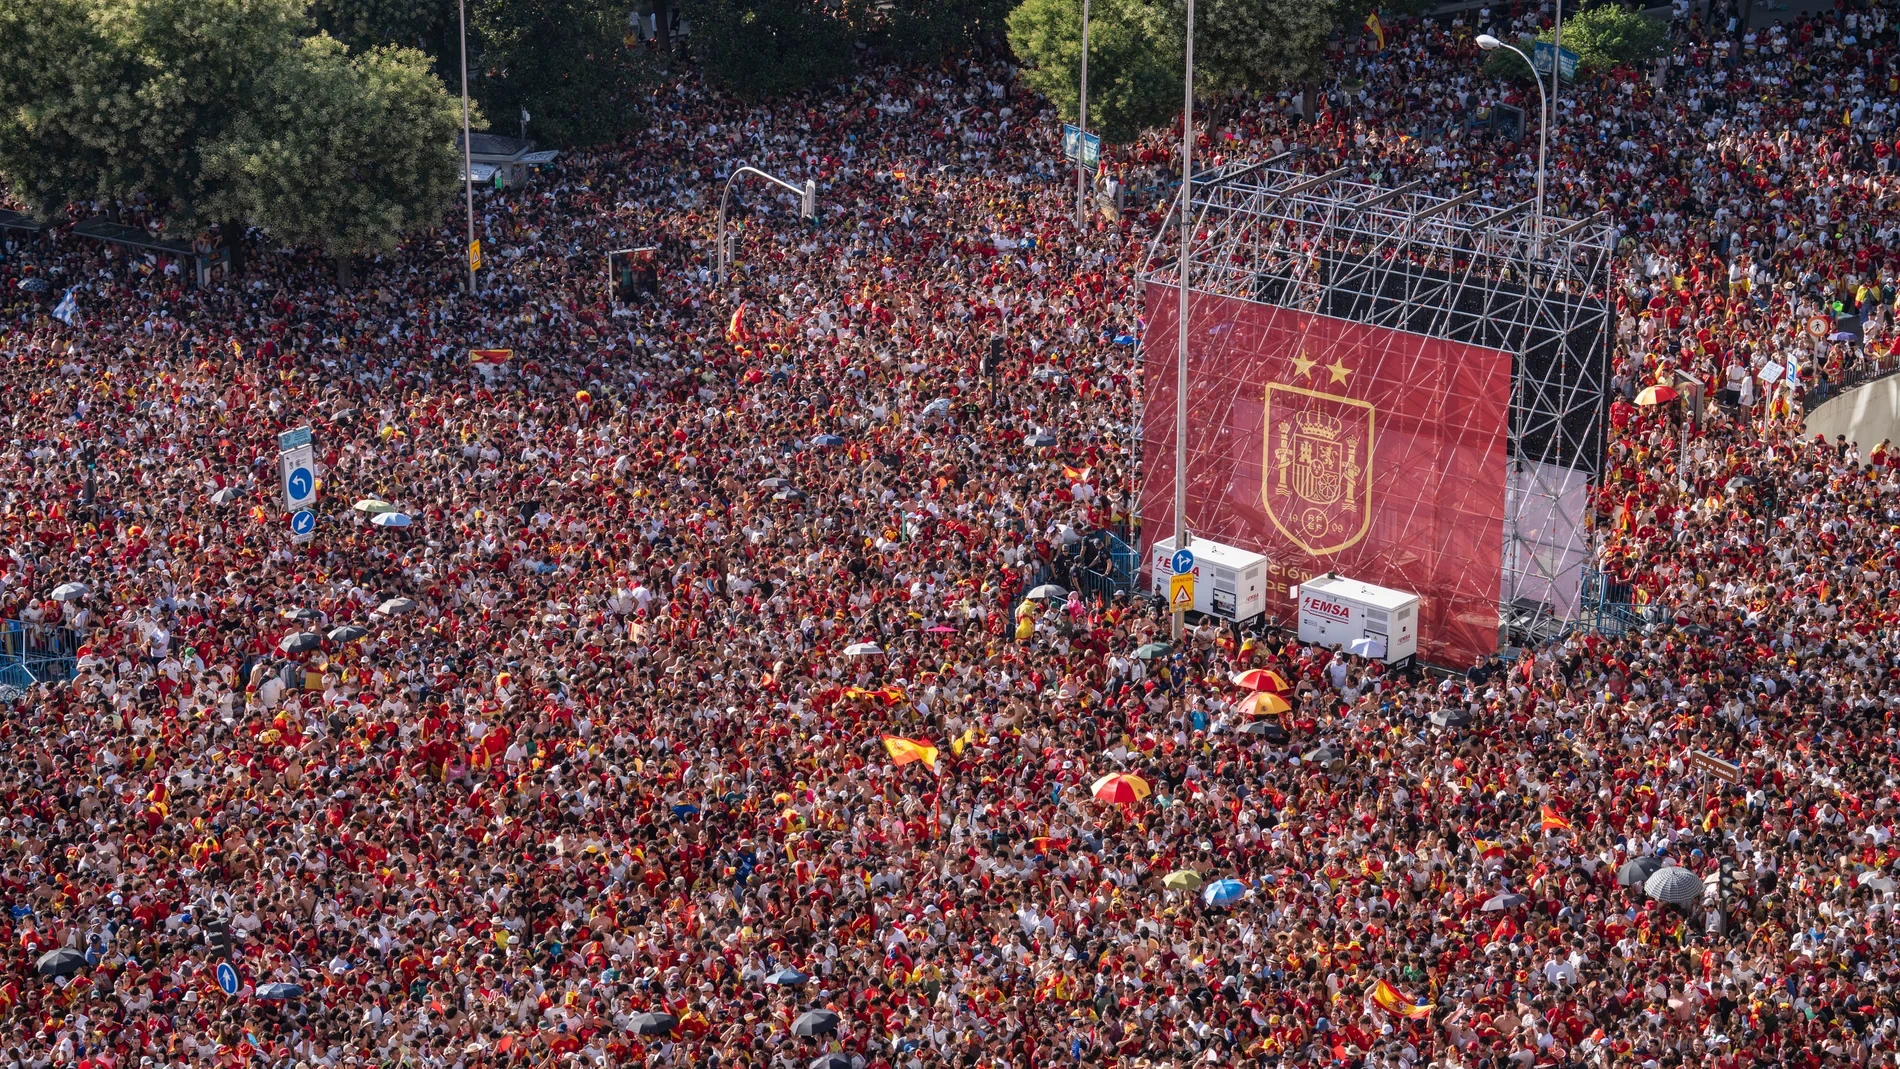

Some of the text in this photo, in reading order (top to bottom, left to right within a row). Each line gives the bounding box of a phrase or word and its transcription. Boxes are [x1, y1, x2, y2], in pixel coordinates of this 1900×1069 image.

[1163, 558, 1199, 577] EA
[1268, 564, 1313, 582] CIÓN
[1310, 598, 1349, 618] EMSA
[1695, 758, 1706, 767] Casa
